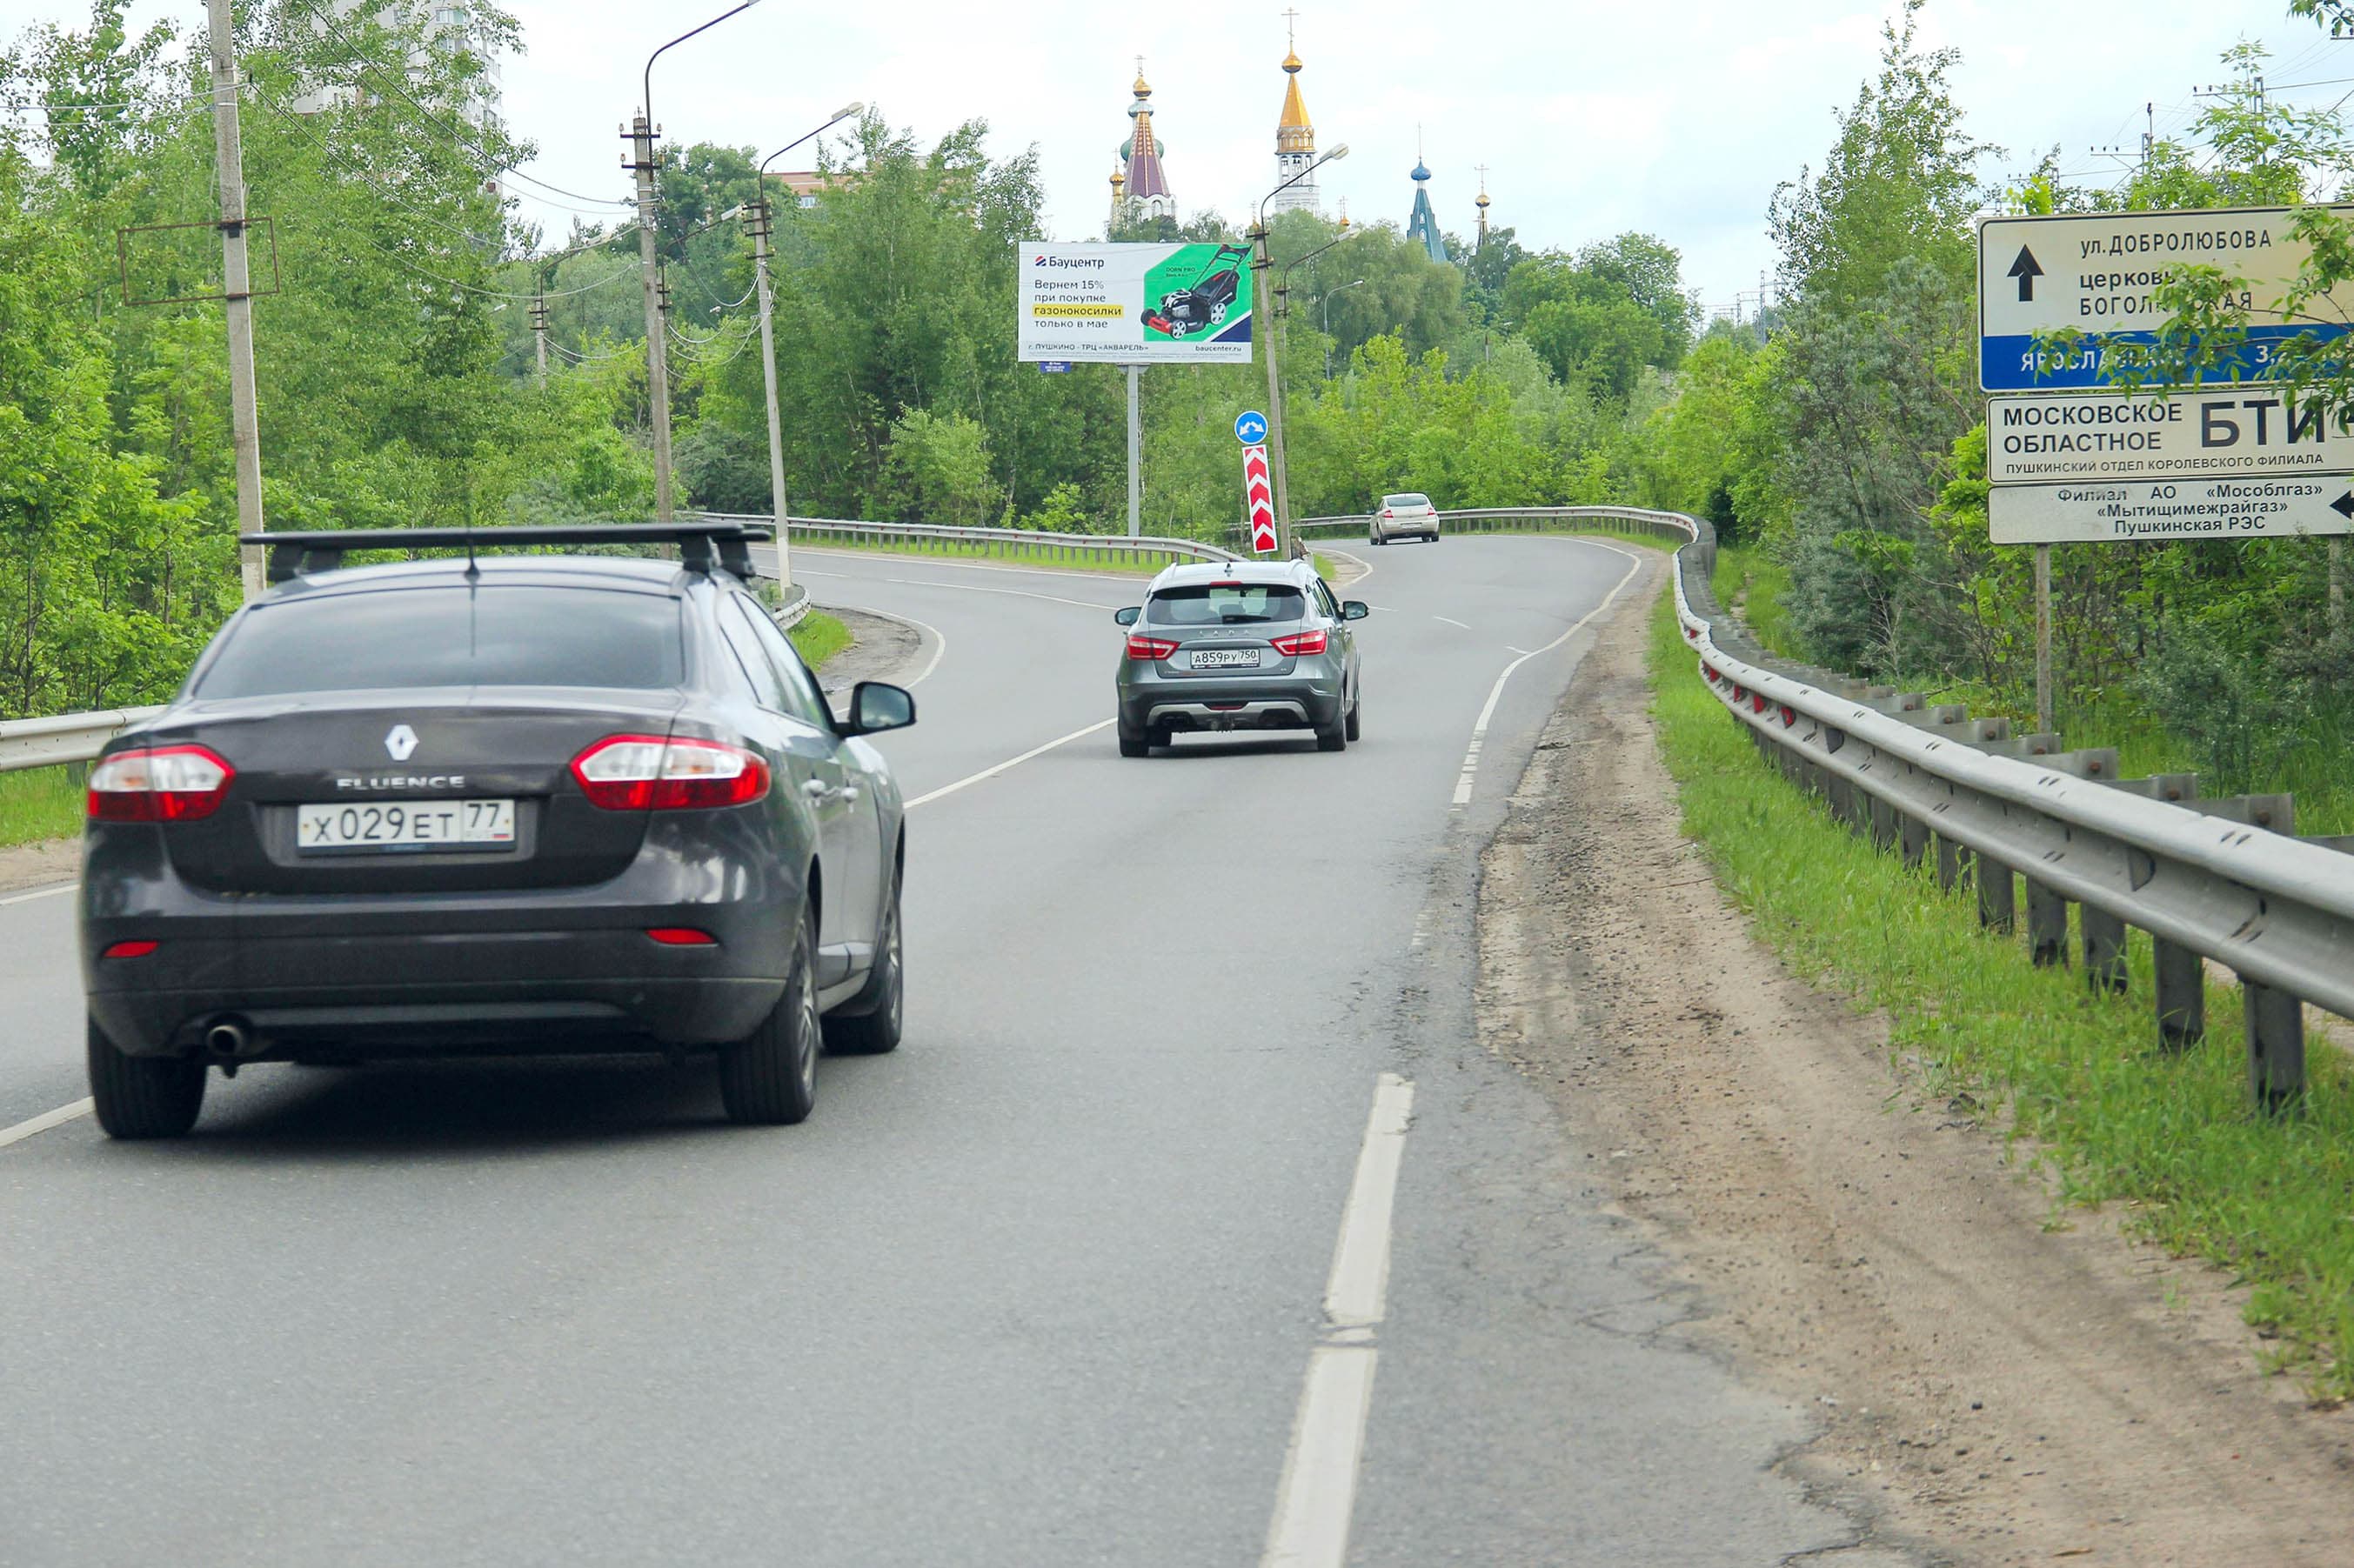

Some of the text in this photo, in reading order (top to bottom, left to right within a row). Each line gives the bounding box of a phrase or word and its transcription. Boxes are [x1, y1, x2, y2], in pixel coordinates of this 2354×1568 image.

[1048, 256, 1105, 270] Бауцентр
[1034, 279, 1105, 290] Вернем 15%
[1034, 294, 1107, 304] при покупке
[1034, 306, 1121, 316] газонокосилки
[2003, 403, 2183, 427] МОСКОВСКОЕ
[2201, 399, 2325, 449] БТИ
[2003, 431, 2163, 454] ОБЛАСТНОЕ
[2006, 453, 2324, 475] ПУШКИНСКИЙ ОТДЕЛ КОРОЛЕВСКОГО ФИЛИАЛА
[2057, 483, 2324, 503] Филиал АО «Мособлгаз»
[2097, 498, 2289, 518] «Мытищимежрайгаз»
[2114, 516, 2267, 535] Пушкинская РЭС
[337, 776, 466, 791] FLUENCE
